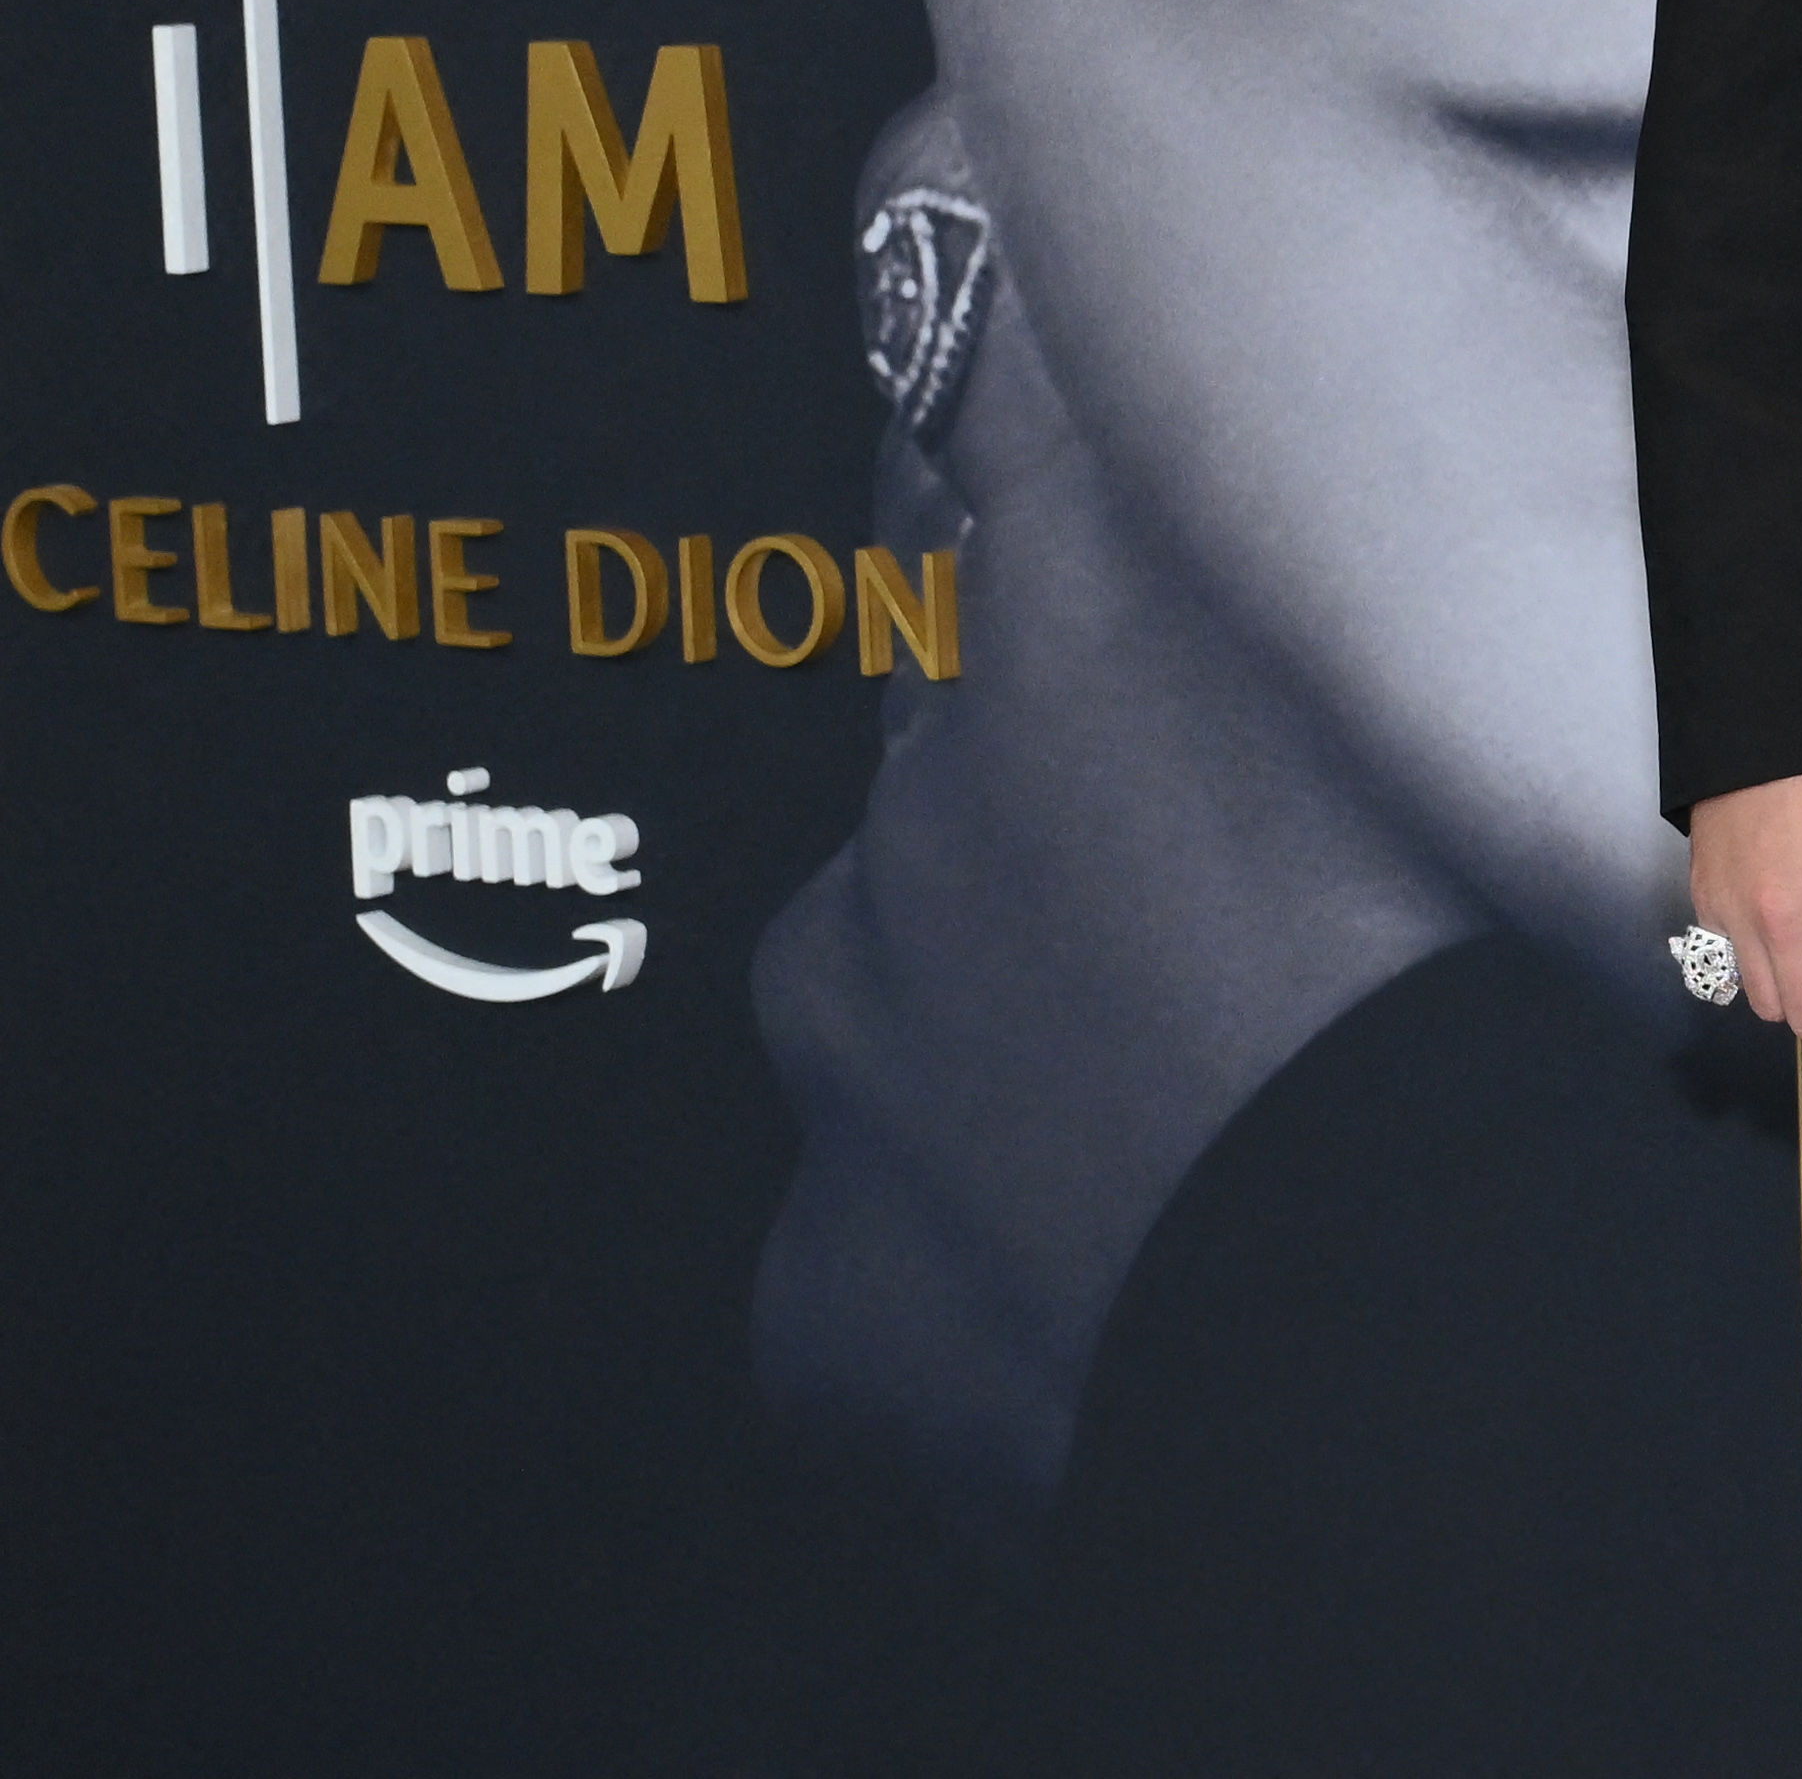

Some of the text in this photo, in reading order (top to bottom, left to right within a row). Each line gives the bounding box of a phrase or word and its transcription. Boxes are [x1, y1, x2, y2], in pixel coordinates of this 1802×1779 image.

[318, 35, 749, 303] AM
[1, 485, 961, 680] CELINE DION
[350, 767, 641, 898] prime
